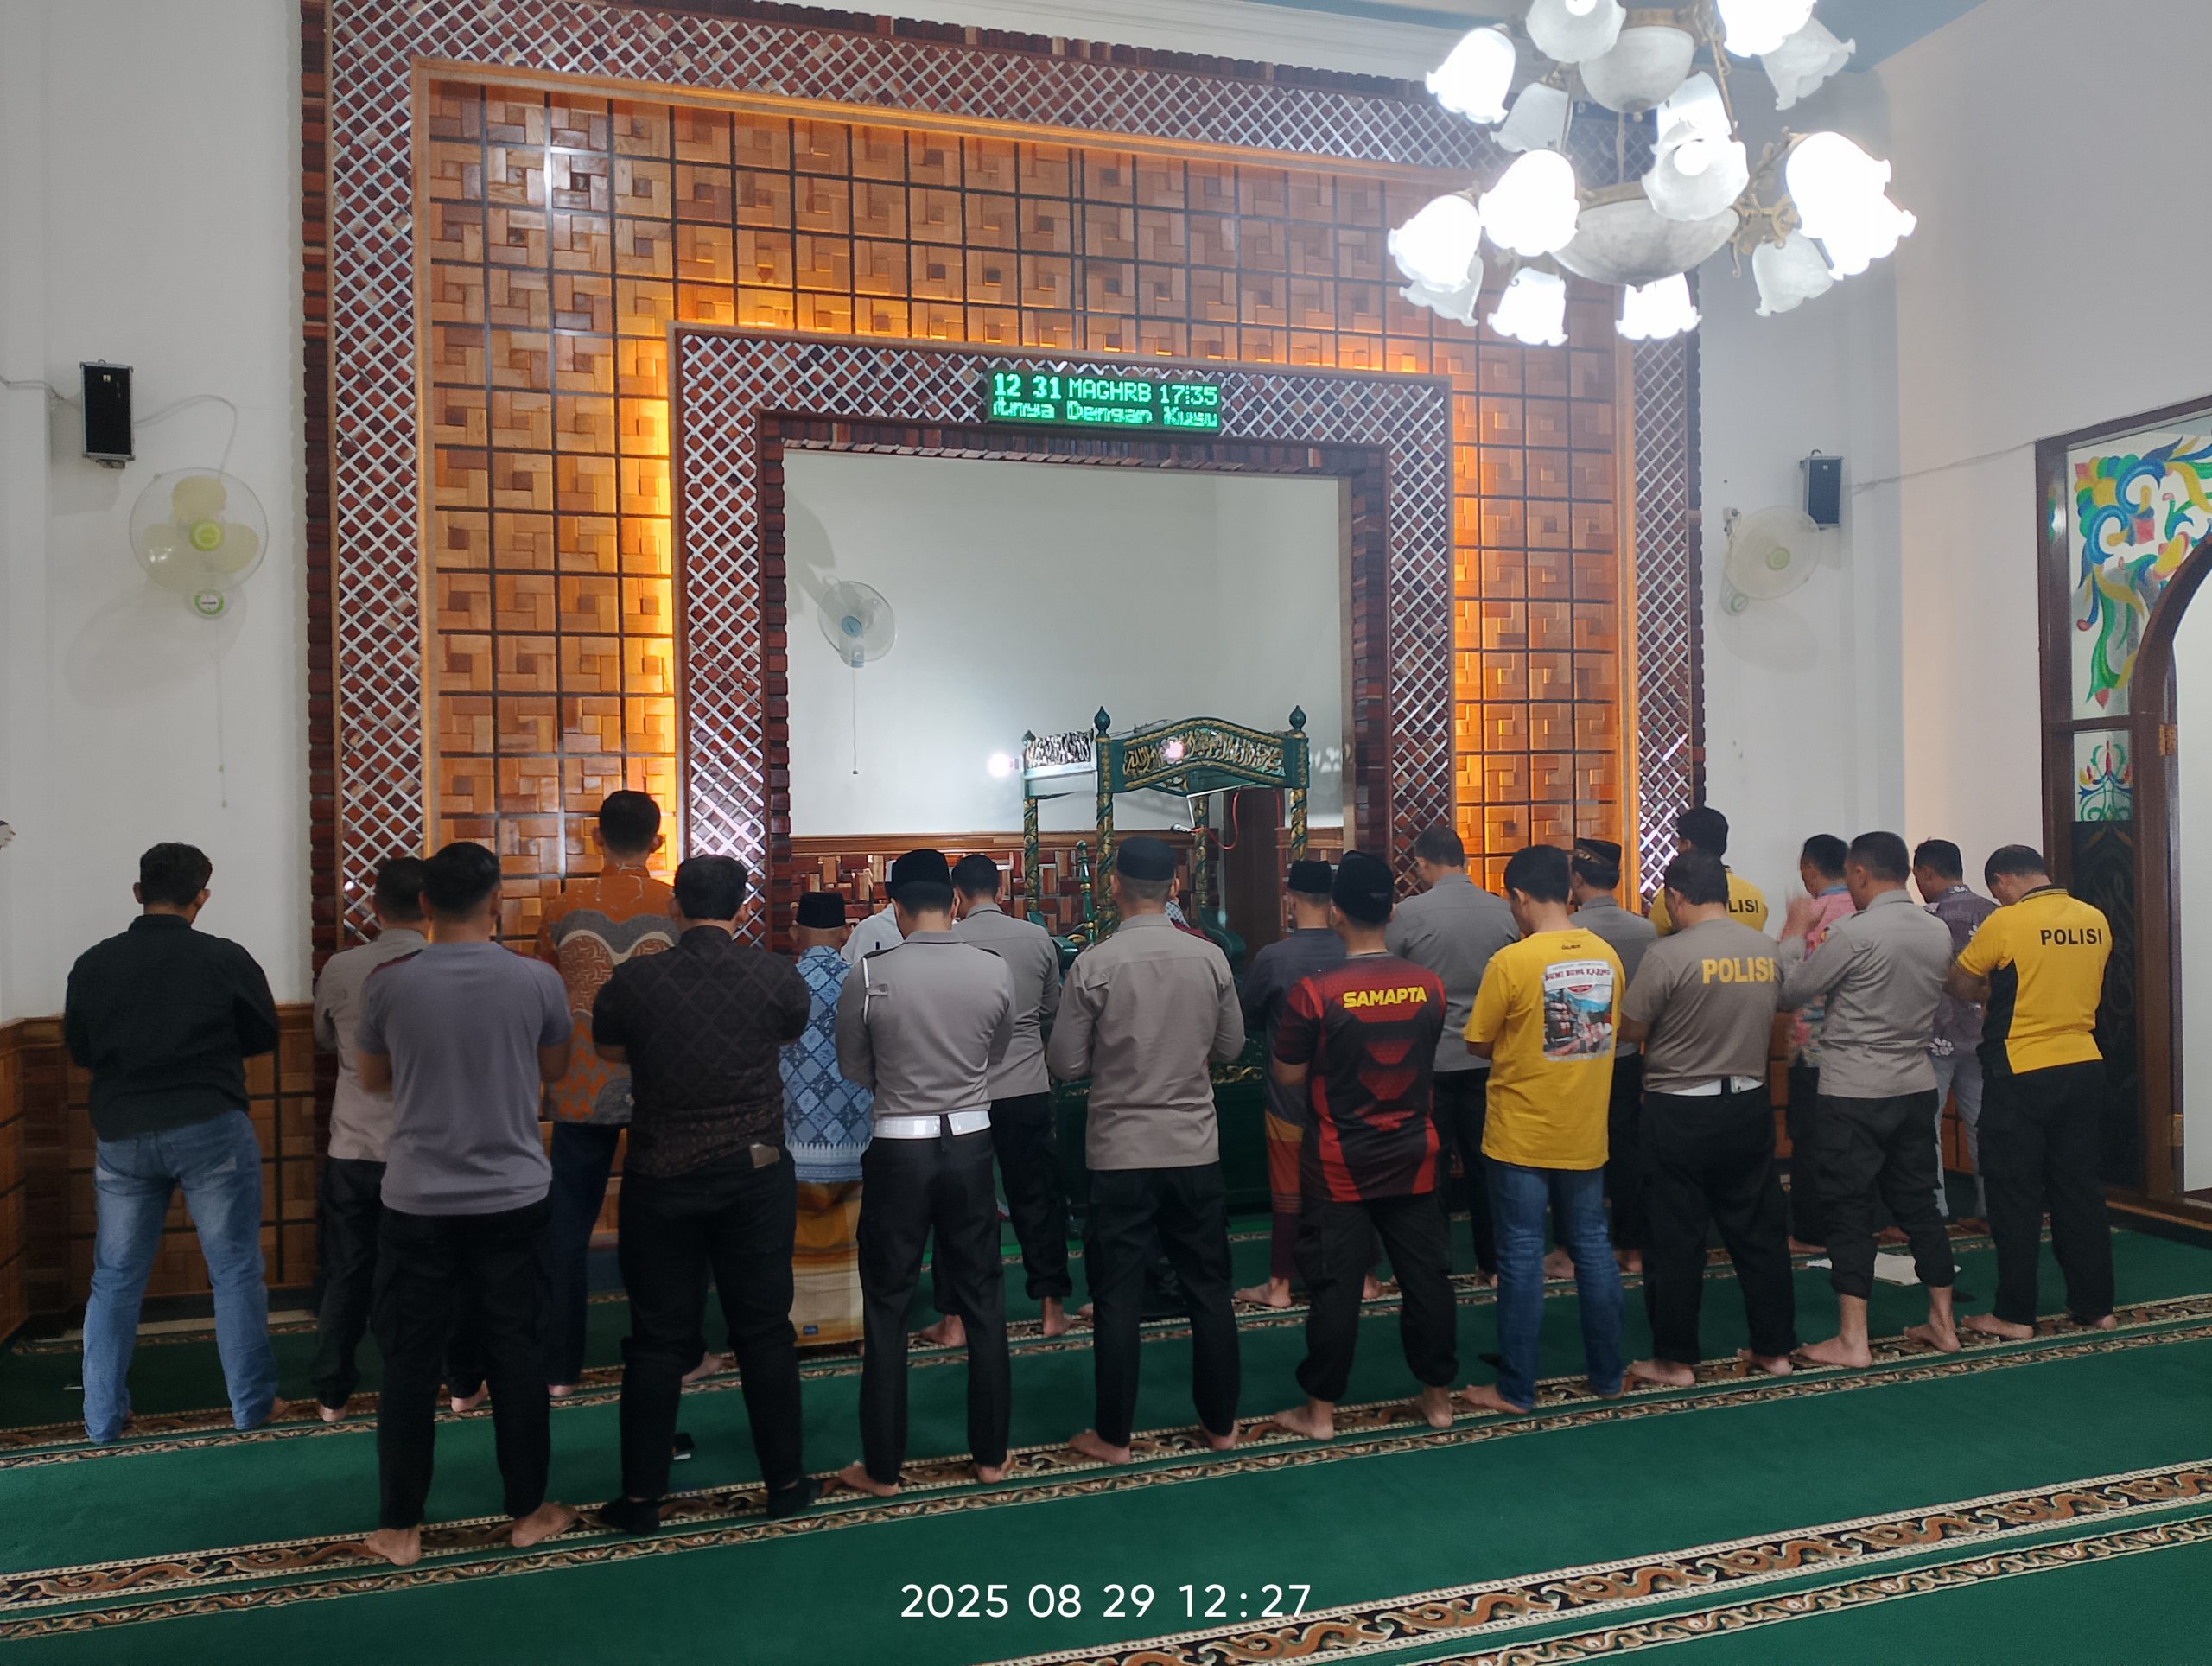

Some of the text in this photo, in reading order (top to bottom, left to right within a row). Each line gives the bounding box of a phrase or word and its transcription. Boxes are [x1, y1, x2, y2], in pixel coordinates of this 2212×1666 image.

[994, 372, 1218, 406] 12 31 MAGHRB 17:35
[1728, 900, 1759, 914] LISI
[2040, 928, 2102, 946] POLISI
[1701, 957, 1775, 984] POLISI
[1342, 986, 1427, 1008] SAMAPTA
